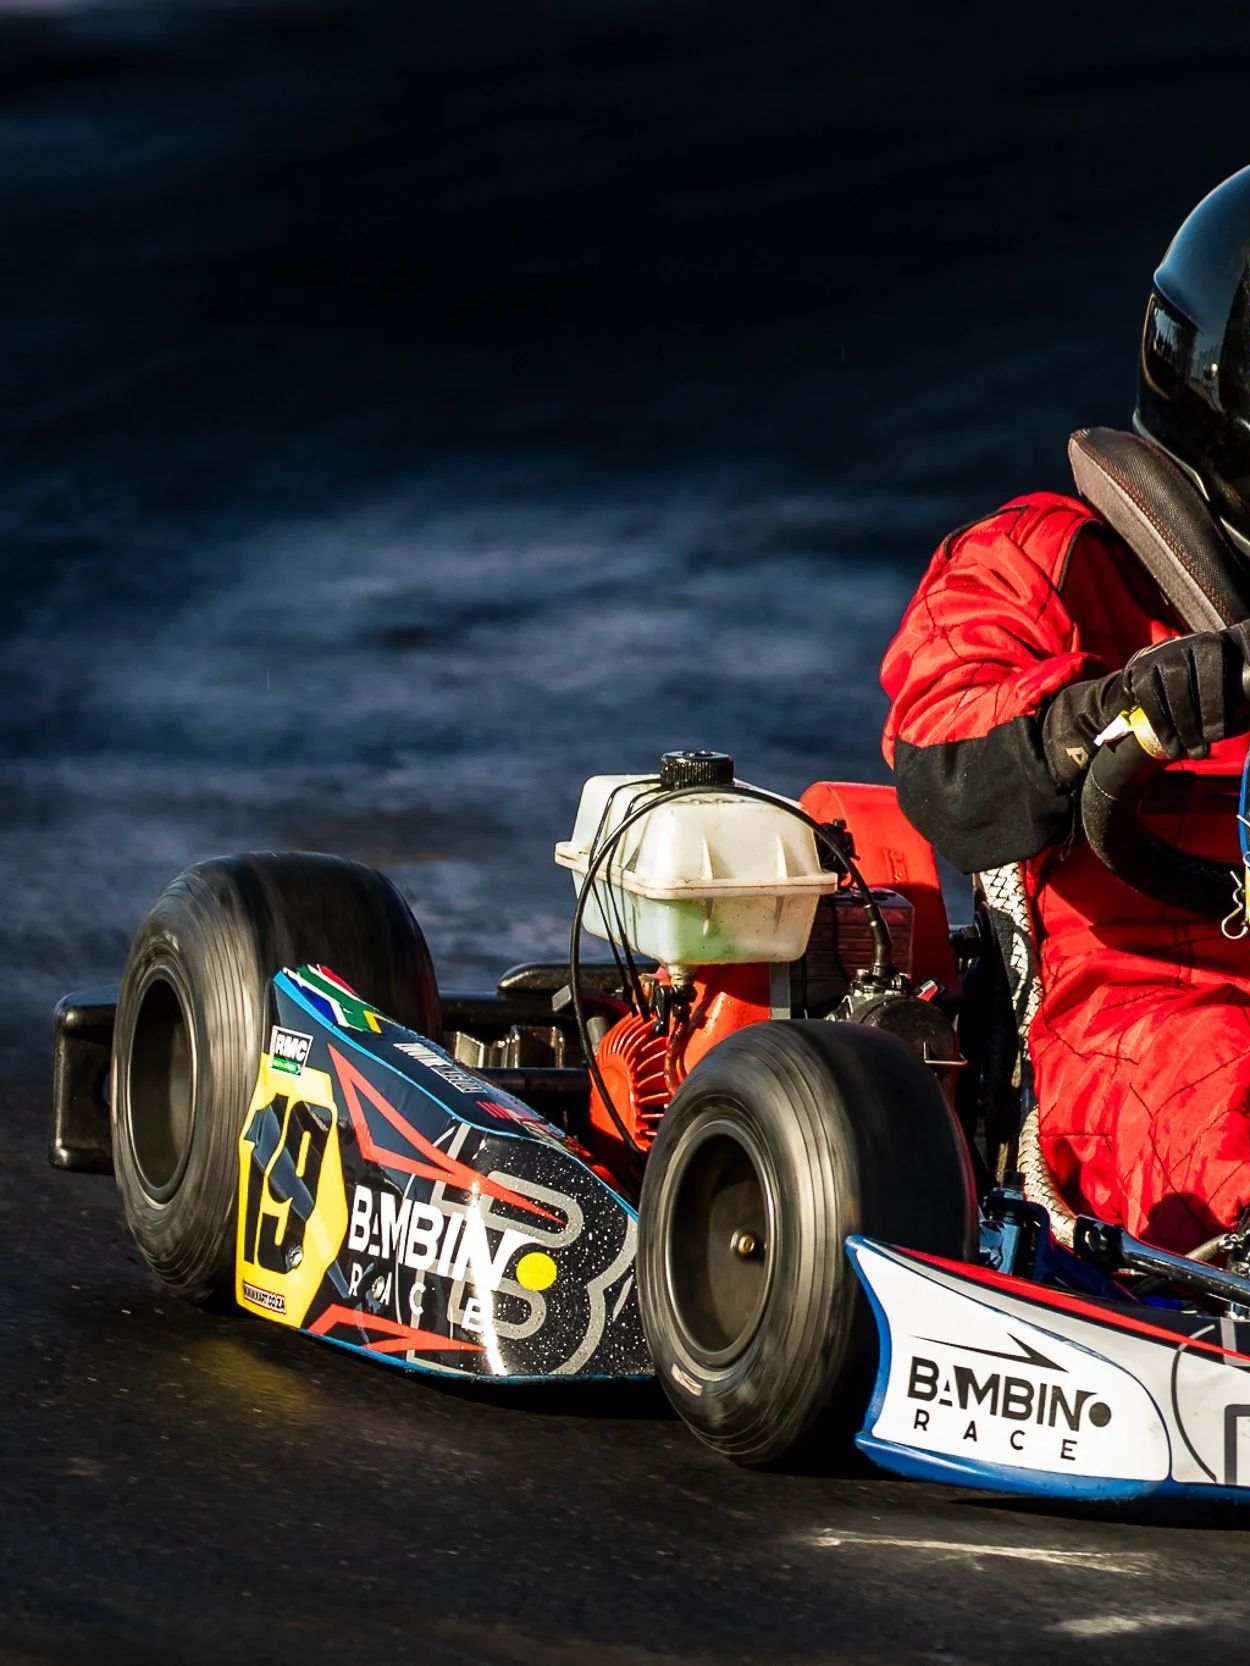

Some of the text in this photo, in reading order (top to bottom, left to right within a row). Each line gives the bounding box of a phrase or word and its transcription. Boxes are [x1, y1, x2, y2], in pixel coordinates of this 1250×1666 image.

[274, 1032, 308, 1062] RMC
[241, 1092, 338, 1275] 19
[348, 1263, 488, 1332] RACE
[914, 1408, 1077, 1461] RACE
